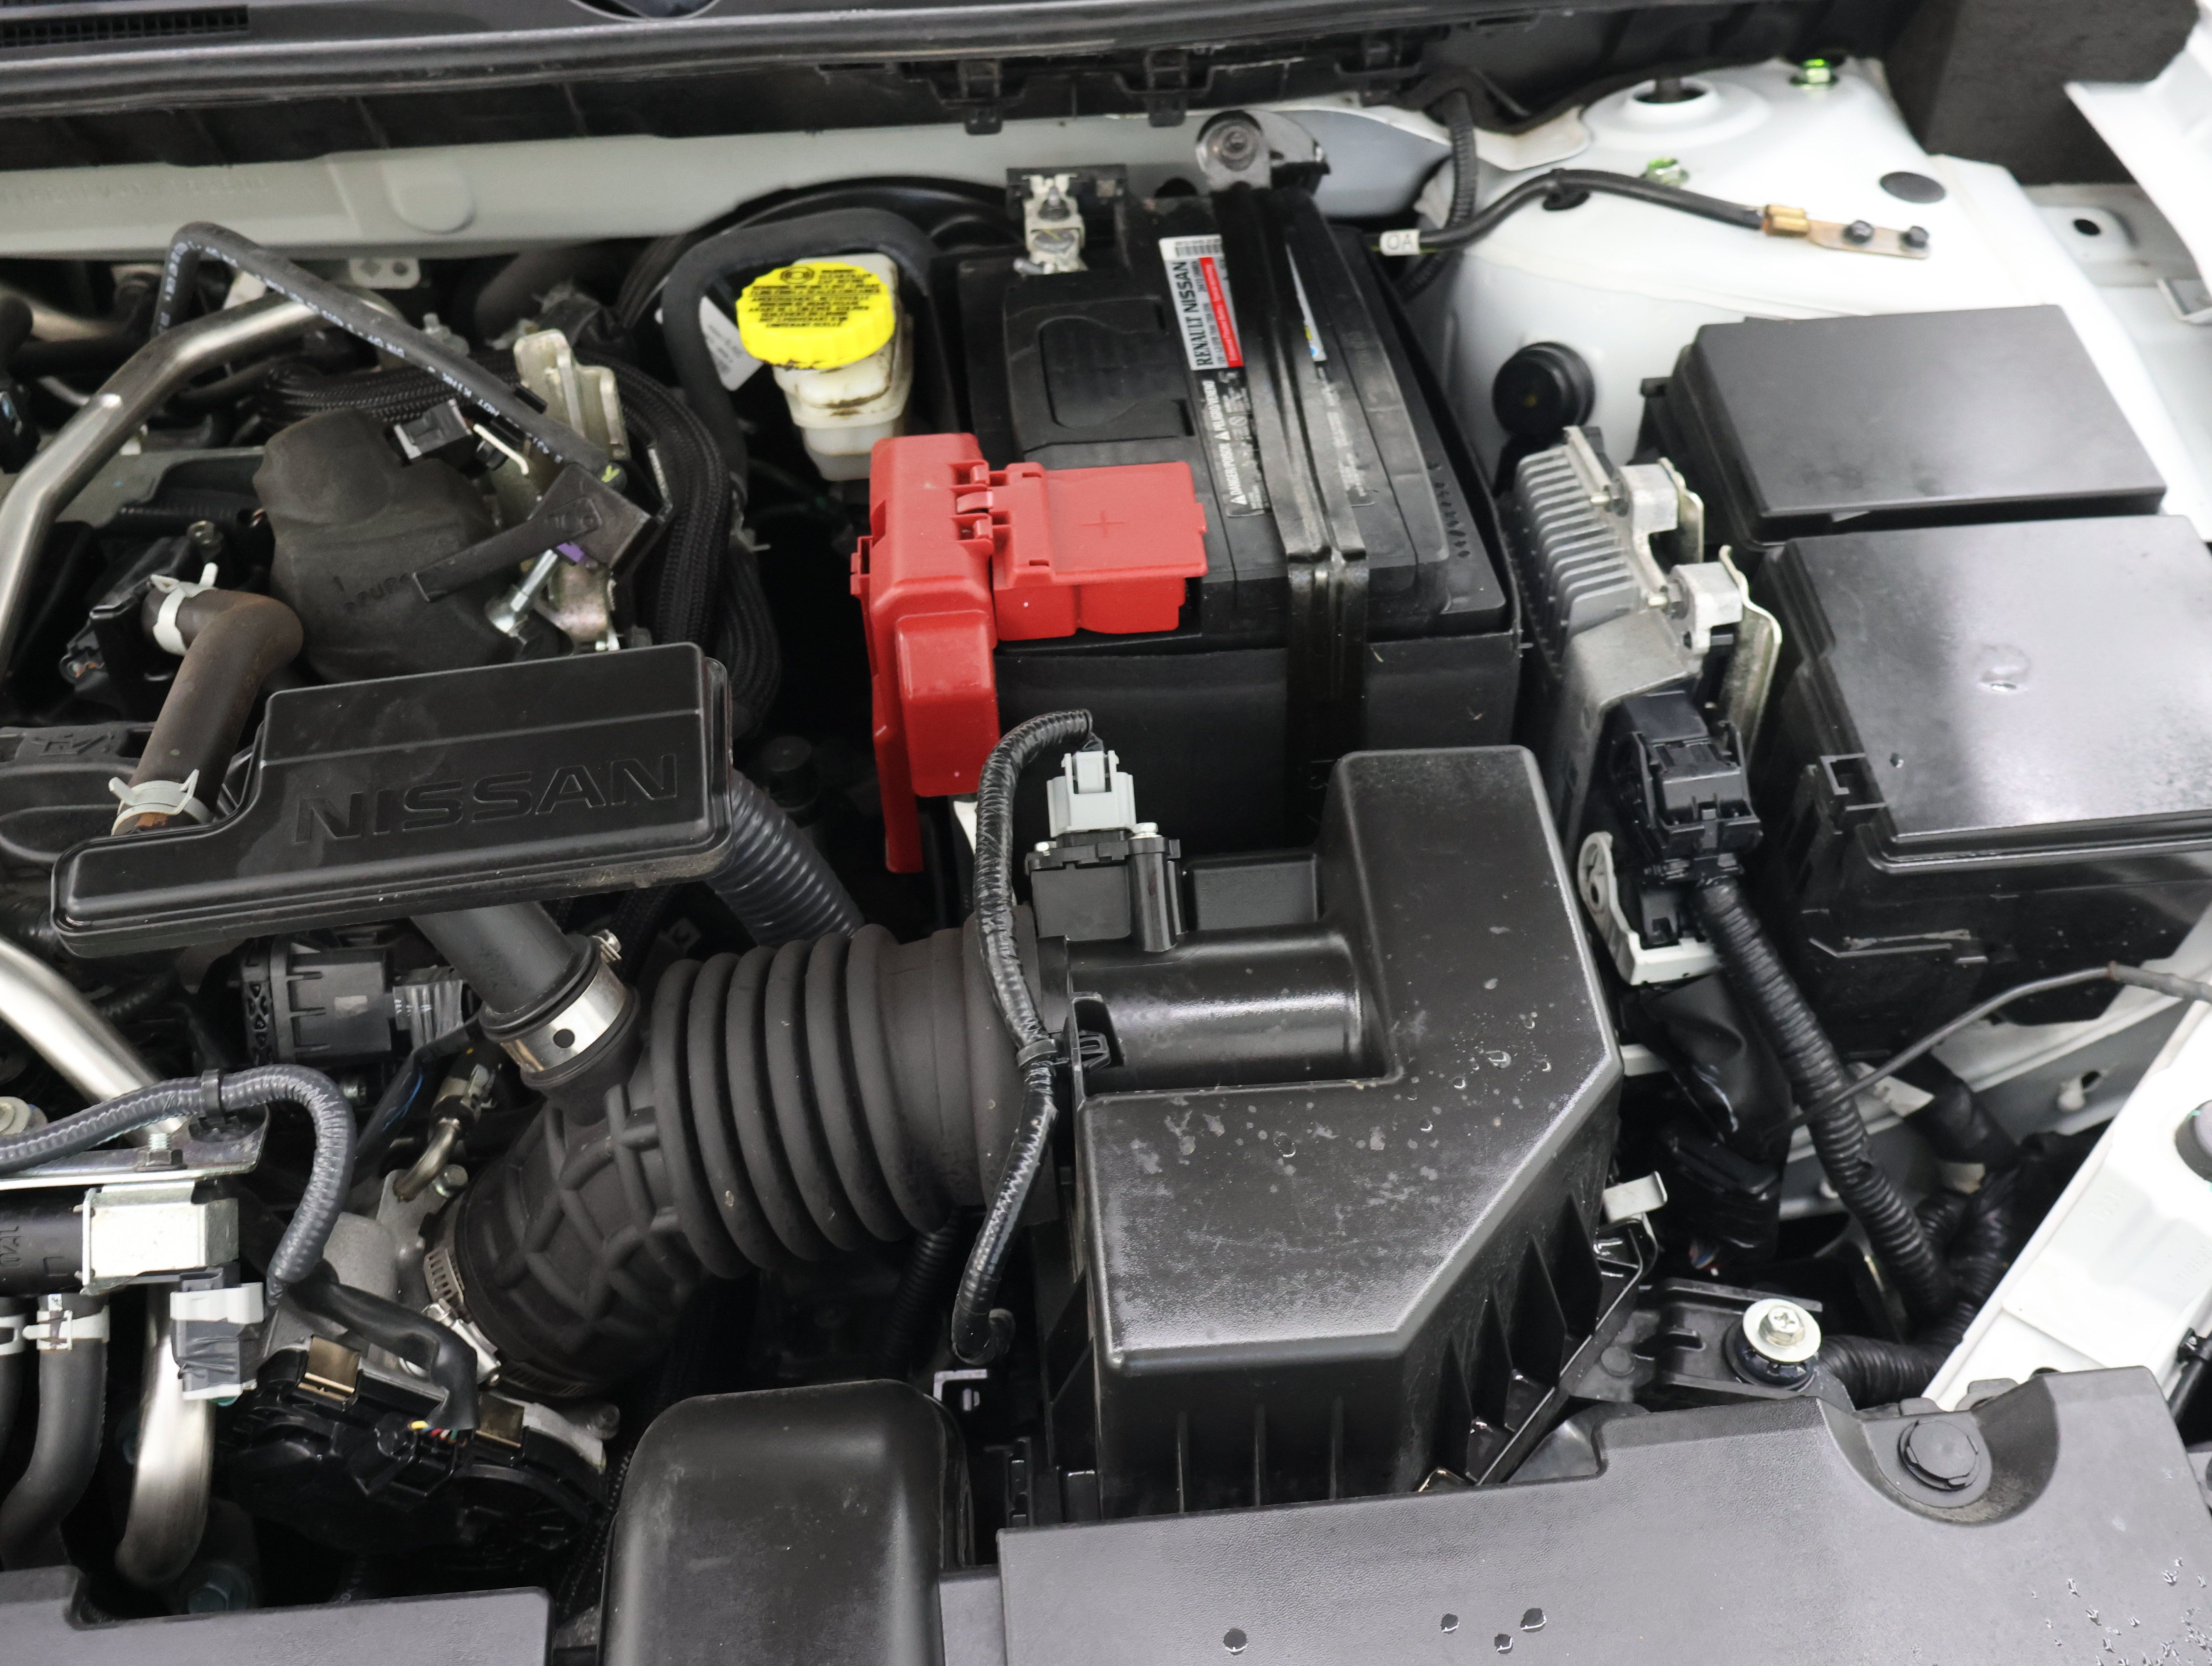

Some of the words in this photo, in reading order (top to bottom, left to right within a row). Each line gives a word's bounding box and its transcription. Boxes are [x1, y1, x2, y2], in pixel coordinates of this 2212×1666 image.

[1173, 261, 1200, 313] NISSAN
[1185, 317, 1213, 366] RENAULT
[1202, 379, 1224, 432] PELIGRO/VENENO
[1220, 443, 1242, 496] DANGER/POISON
[296, 753, 678, 843] NISSAN
